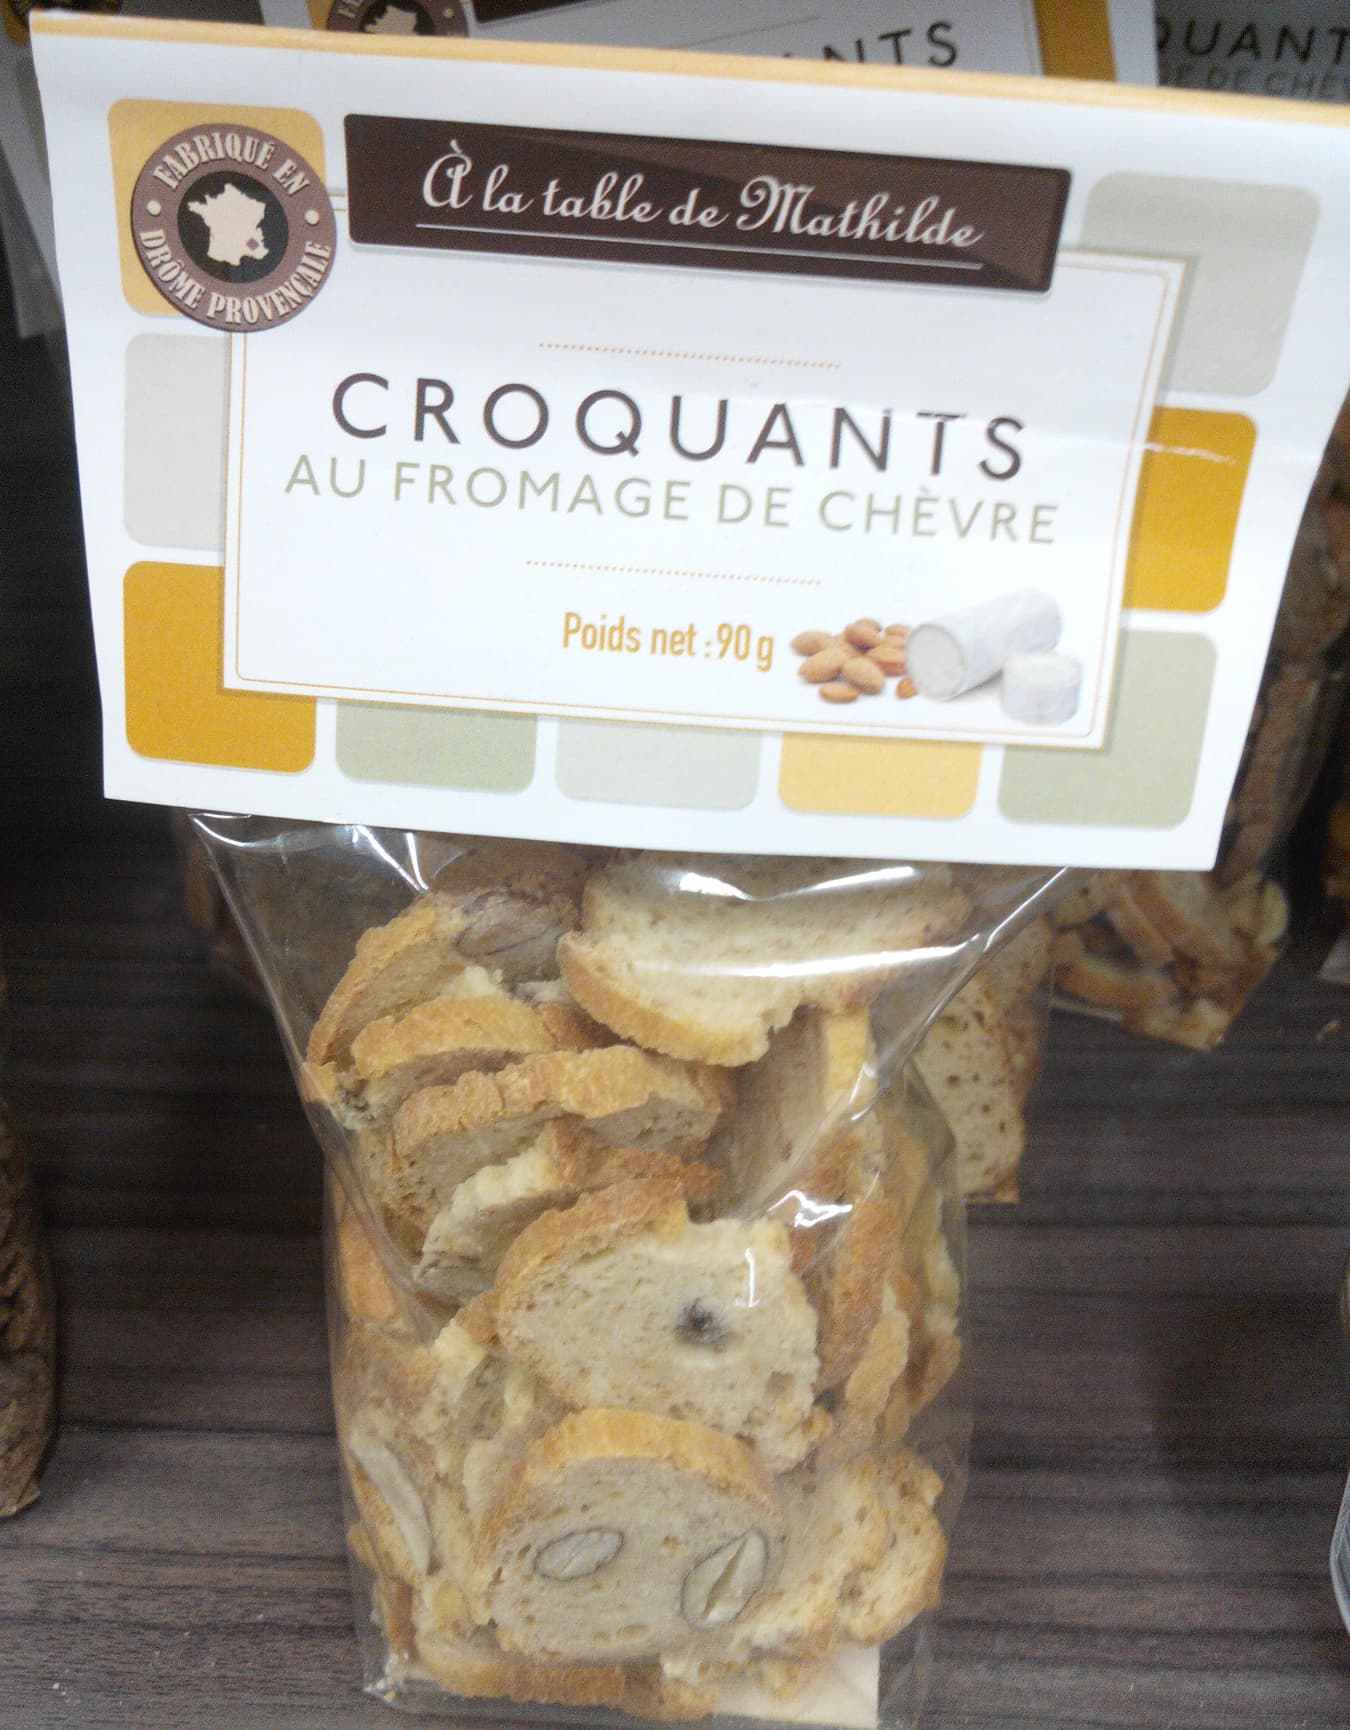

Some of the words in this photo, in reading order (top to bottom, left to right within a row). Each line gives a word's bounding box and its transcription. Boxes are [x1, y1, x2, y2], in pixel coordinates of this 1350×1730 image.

[152, 131, 276, 190] FABRIQUÉ
[272, 158, 311, 196] EN
[422, 139, 473, 209] À
[482, 164, 534, 214] la
[541, 171, 663, 223] table
[669, 188, 730, 228] de
[735, 175, 985, 247] Mathilde
[139, 228, 205, 309] DRÔME
[206, 240, 331, 325] PROVENÇALE
[332, 372, 1025, 481] CROQUANTS
[285, 454, 366, 498] AU
[394, 461, 691, 521] FROMAGE
[717, 484, 793, 527] DE
[818, 485, 1059, 544] CHÈVRE
[562, 611, 641, 653] Poids
